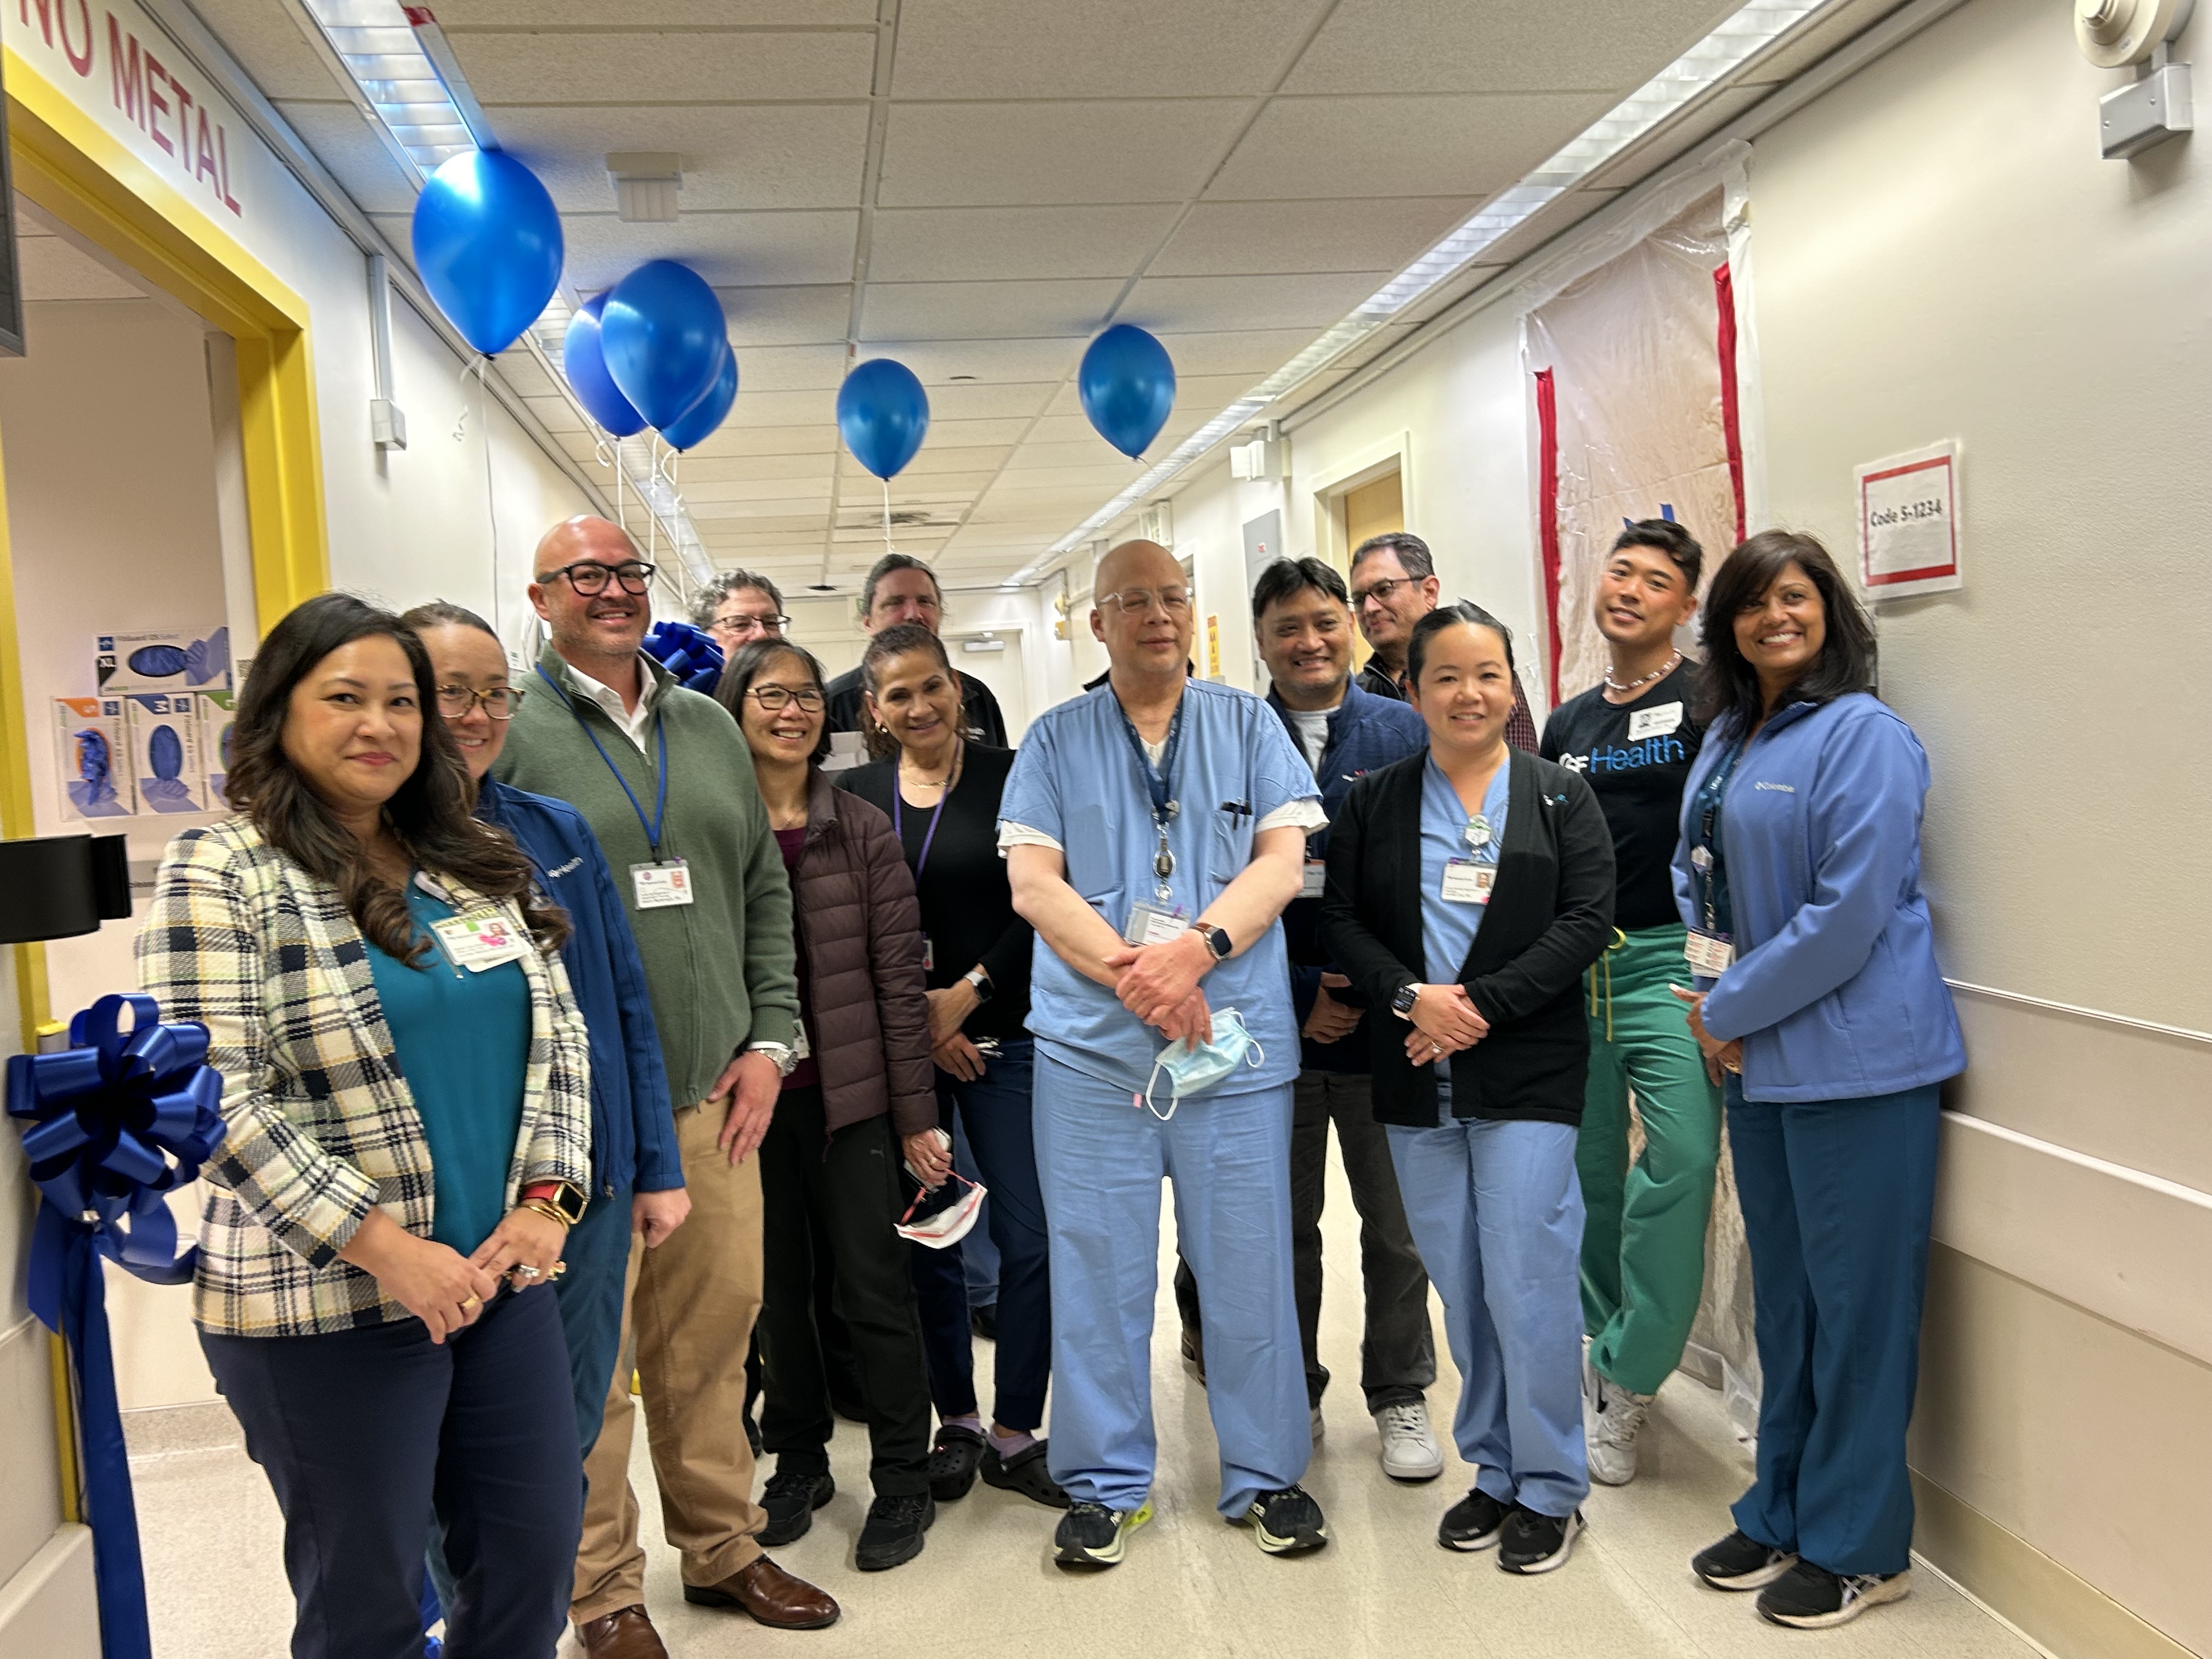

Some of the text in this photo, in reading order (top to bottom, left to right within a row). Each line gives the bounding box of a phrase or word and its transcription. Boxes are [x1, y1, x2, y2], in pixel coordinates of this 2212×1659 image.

[106, 10, 242, 218] METAL
[1870, 498, 1943, 527] Code 5-1234
[154, 701, 168, 712] M
